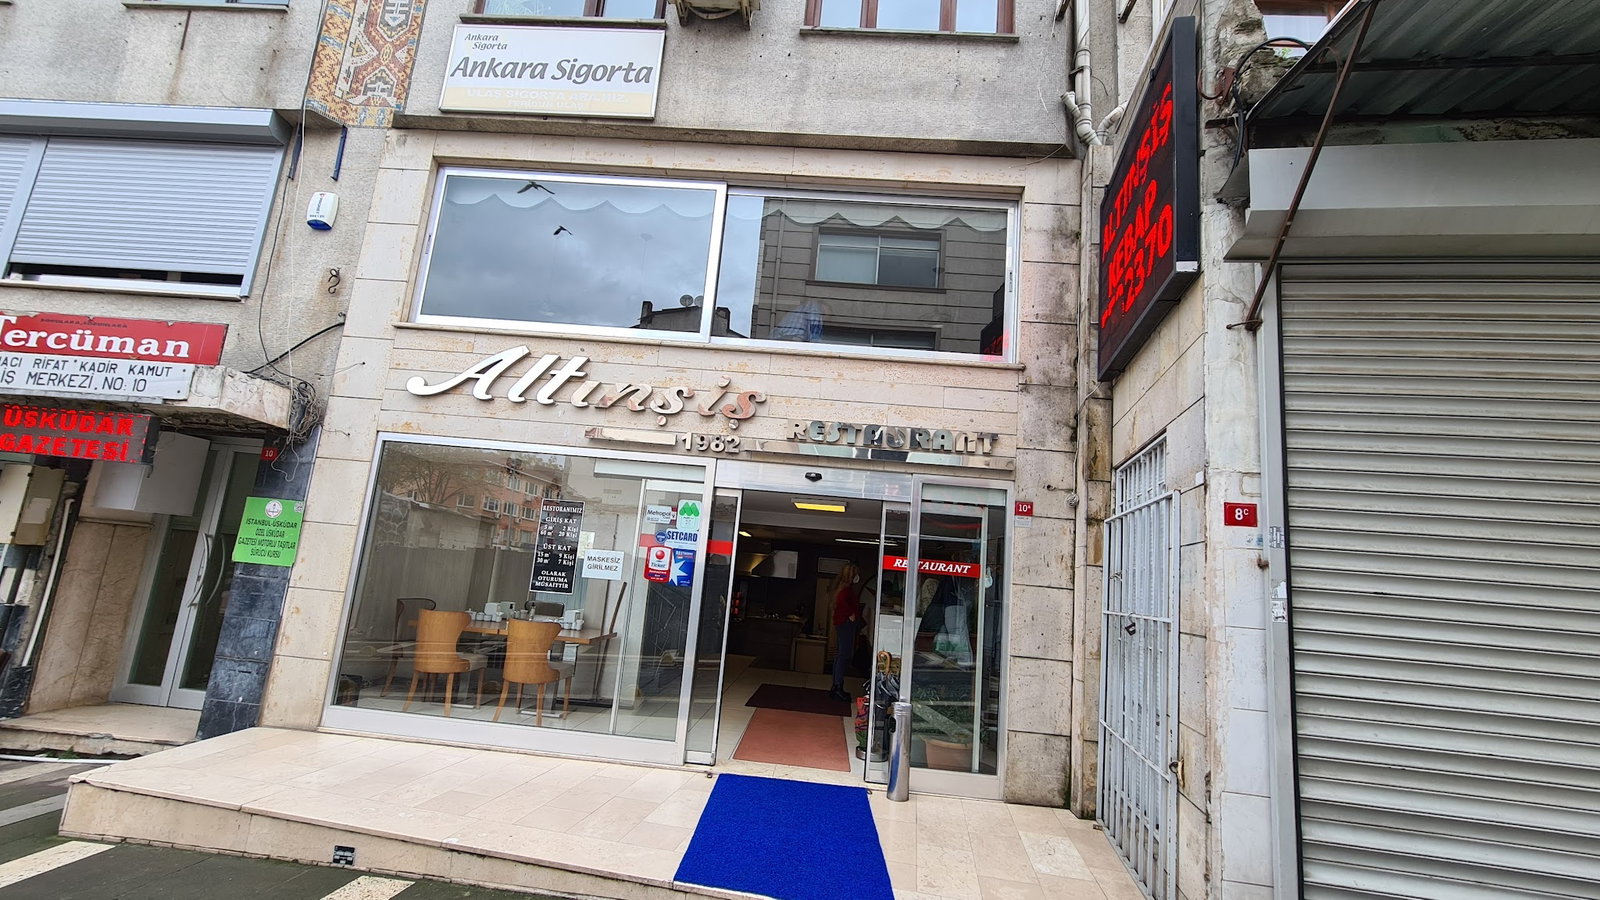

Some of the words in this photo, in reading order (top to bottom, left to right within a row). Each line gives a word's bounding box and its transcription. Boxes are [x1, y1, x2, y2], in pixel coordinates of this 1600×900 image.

[464, 33, 499, 42] Ankara
[472, 42, 508, 51] Sigorta
[450, 56, 549, 80] Ankara
[551, 58, 653, 85] Sigorta
[1109, 180, 1157, 298] KEBAP
[0, 356, 23, 368] ACI
[33, 357, 68, 371] RİFAT
[80, 360, 118, 374] KADİR
[128, 364, 173, 378] KAMUT
[1, 368, 16, 385] İŞ
[132, 378, 147, 393] 10
[4, 405, 134, 437] ÜSKÜDAR
[0, 432, 130, 462] GAZETESİ
[681, 431, 742, 454] 1982
[265, 450, 274, 458] 10
[666, 531, 698, 542] SETCARD
[543, 542, 556, 550] ÜST
[587, 555, 621, 564] MASKESİZ
[587, 563, 619, 572] GİRİLMEZ
[893, 558, 972, 574] RETAURANT
